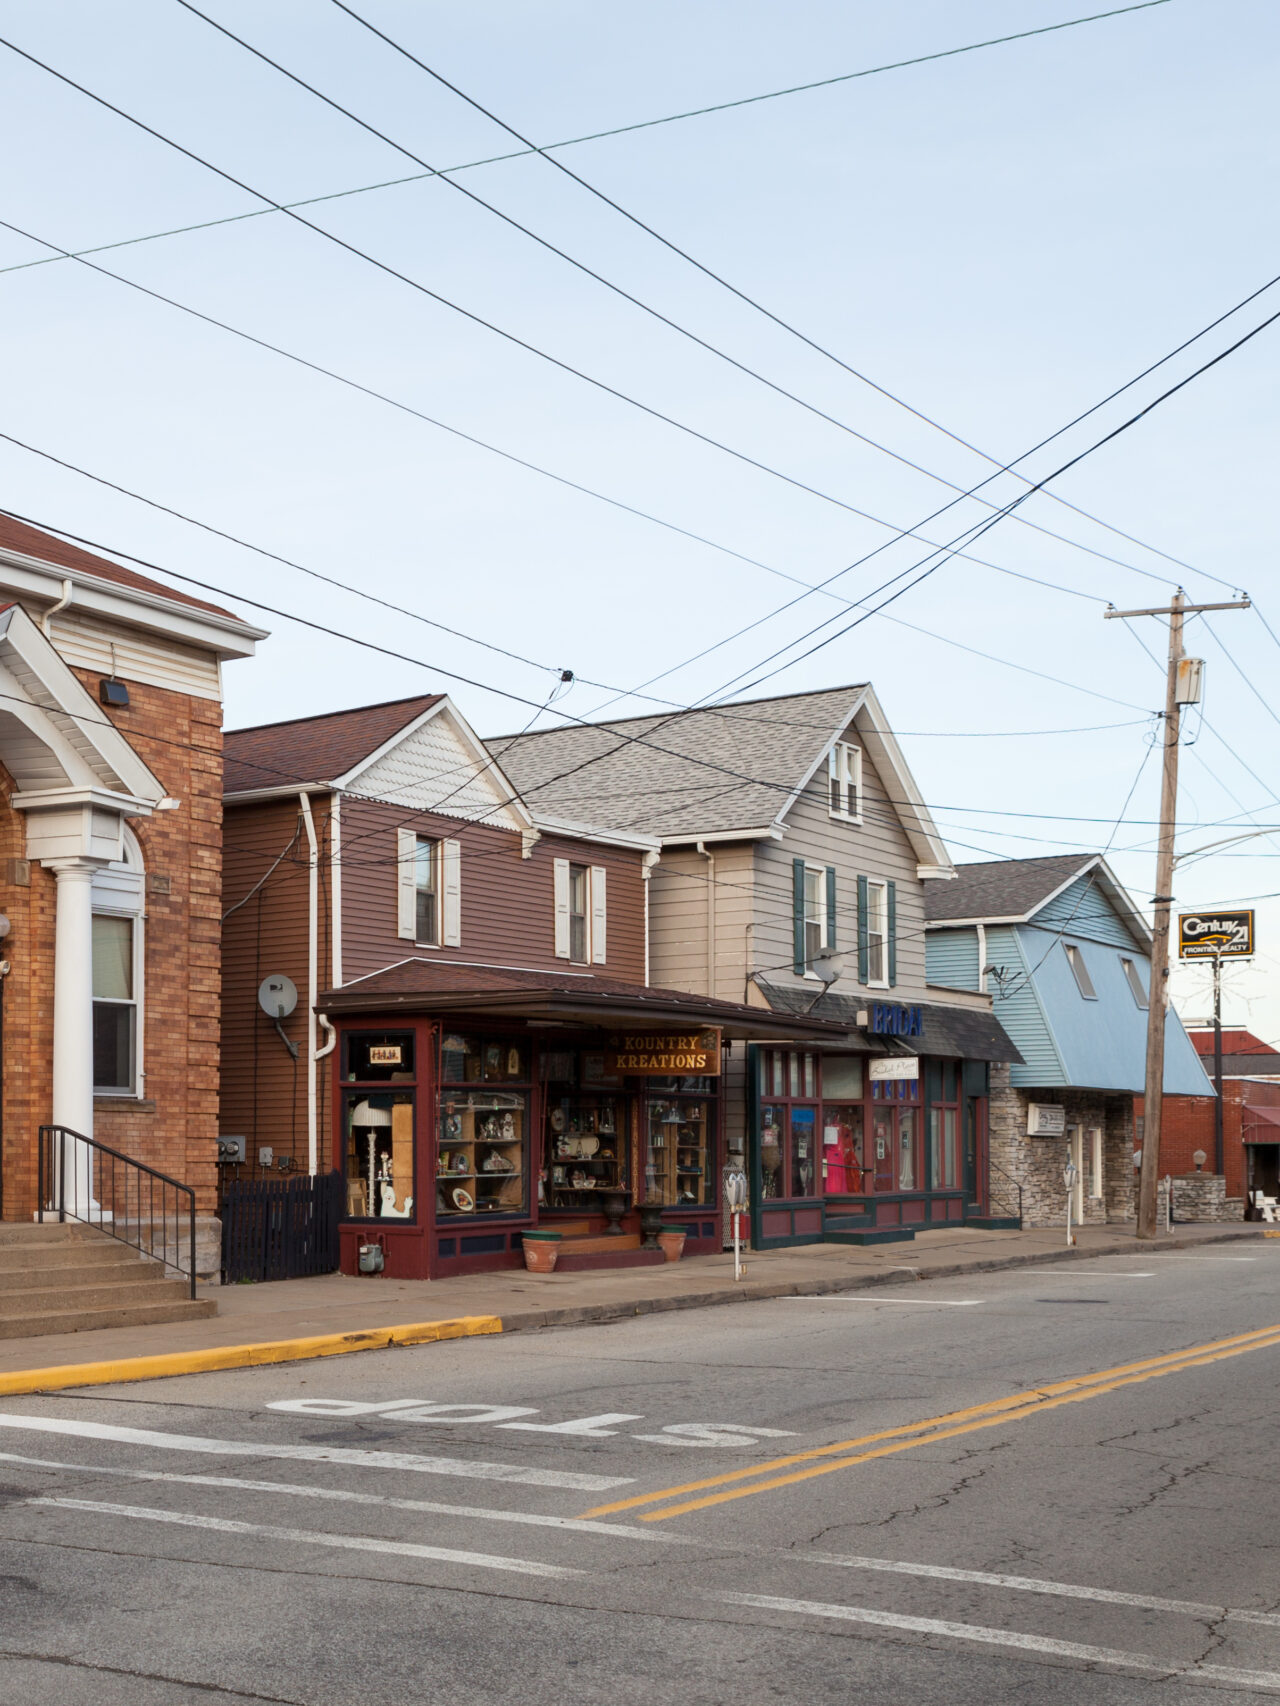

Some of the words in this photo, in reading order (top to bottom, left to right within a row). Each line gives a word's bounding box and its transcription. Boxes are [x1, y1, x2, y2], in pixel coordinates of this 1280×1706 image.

[1183, 917, 1238, 935] Century
[1232, 926, 1248, 943] 21
[873, 1003, 925, 1037] BRIDAL
[624, 1036, 700, 1050] KOUNTRY
[616, 1053, 707, 1068] KREATIONS
[265, 1398, 803, 1448] STOP
